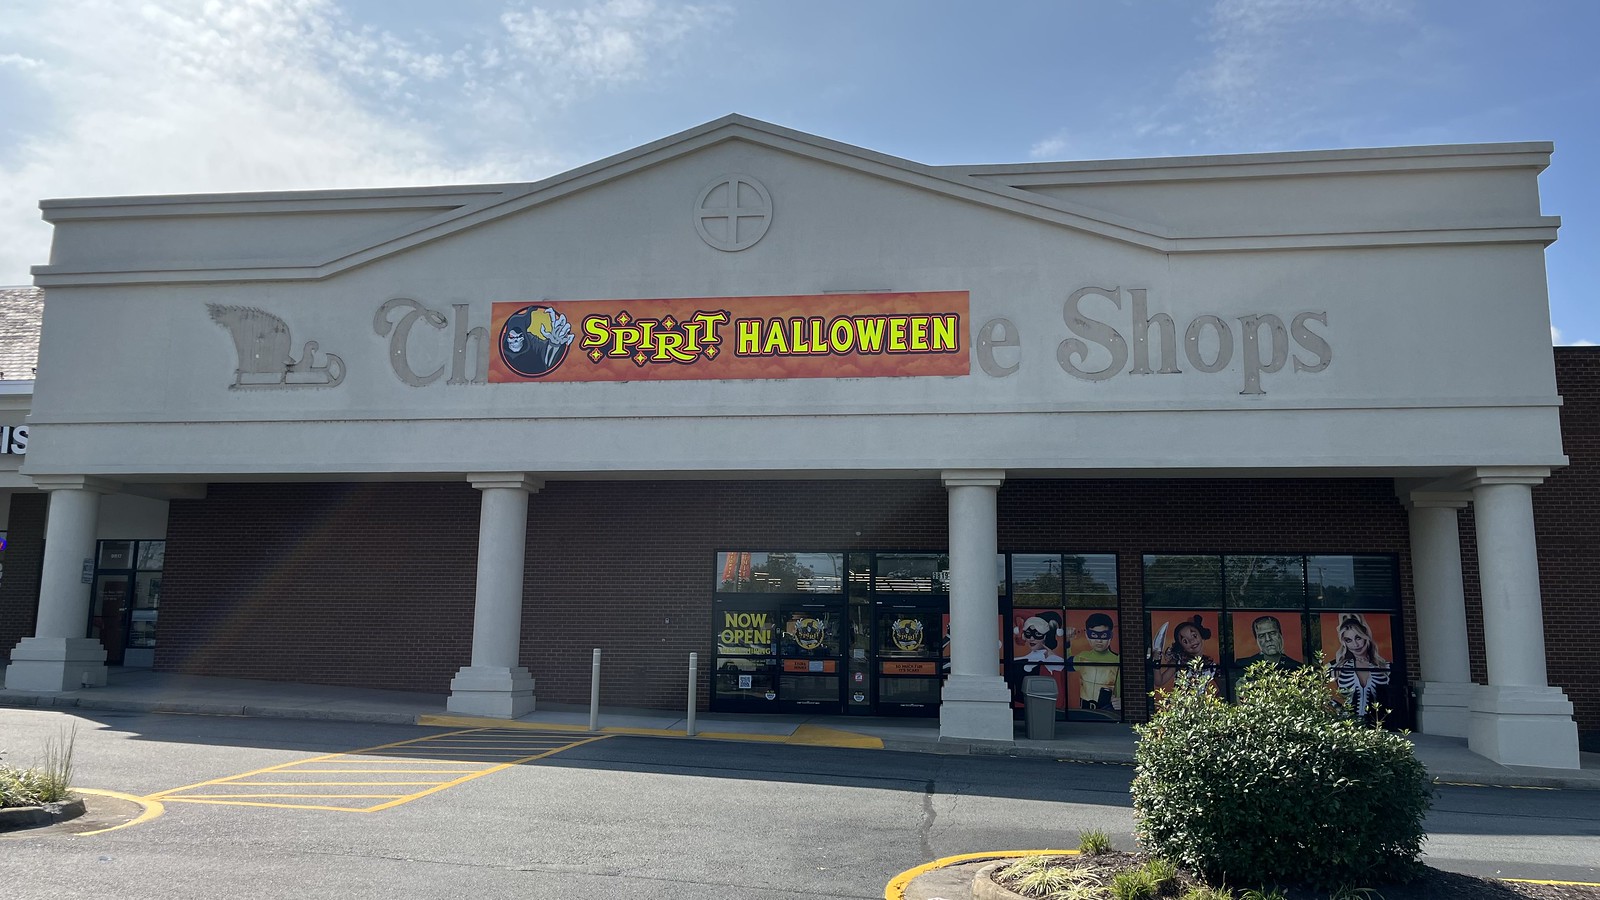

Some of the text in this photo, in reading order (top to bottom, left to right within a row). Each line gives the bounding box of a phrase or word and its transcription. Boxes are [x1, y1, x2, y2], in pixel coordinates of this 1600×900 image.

[373, 285, 1332, 395] Ch e Shops
[583, 312, 957, 364] SPIRIT HALLOWEEN
[721, 629, 771, 644] OPEN!
[725, 613, 767, 628] NOW
